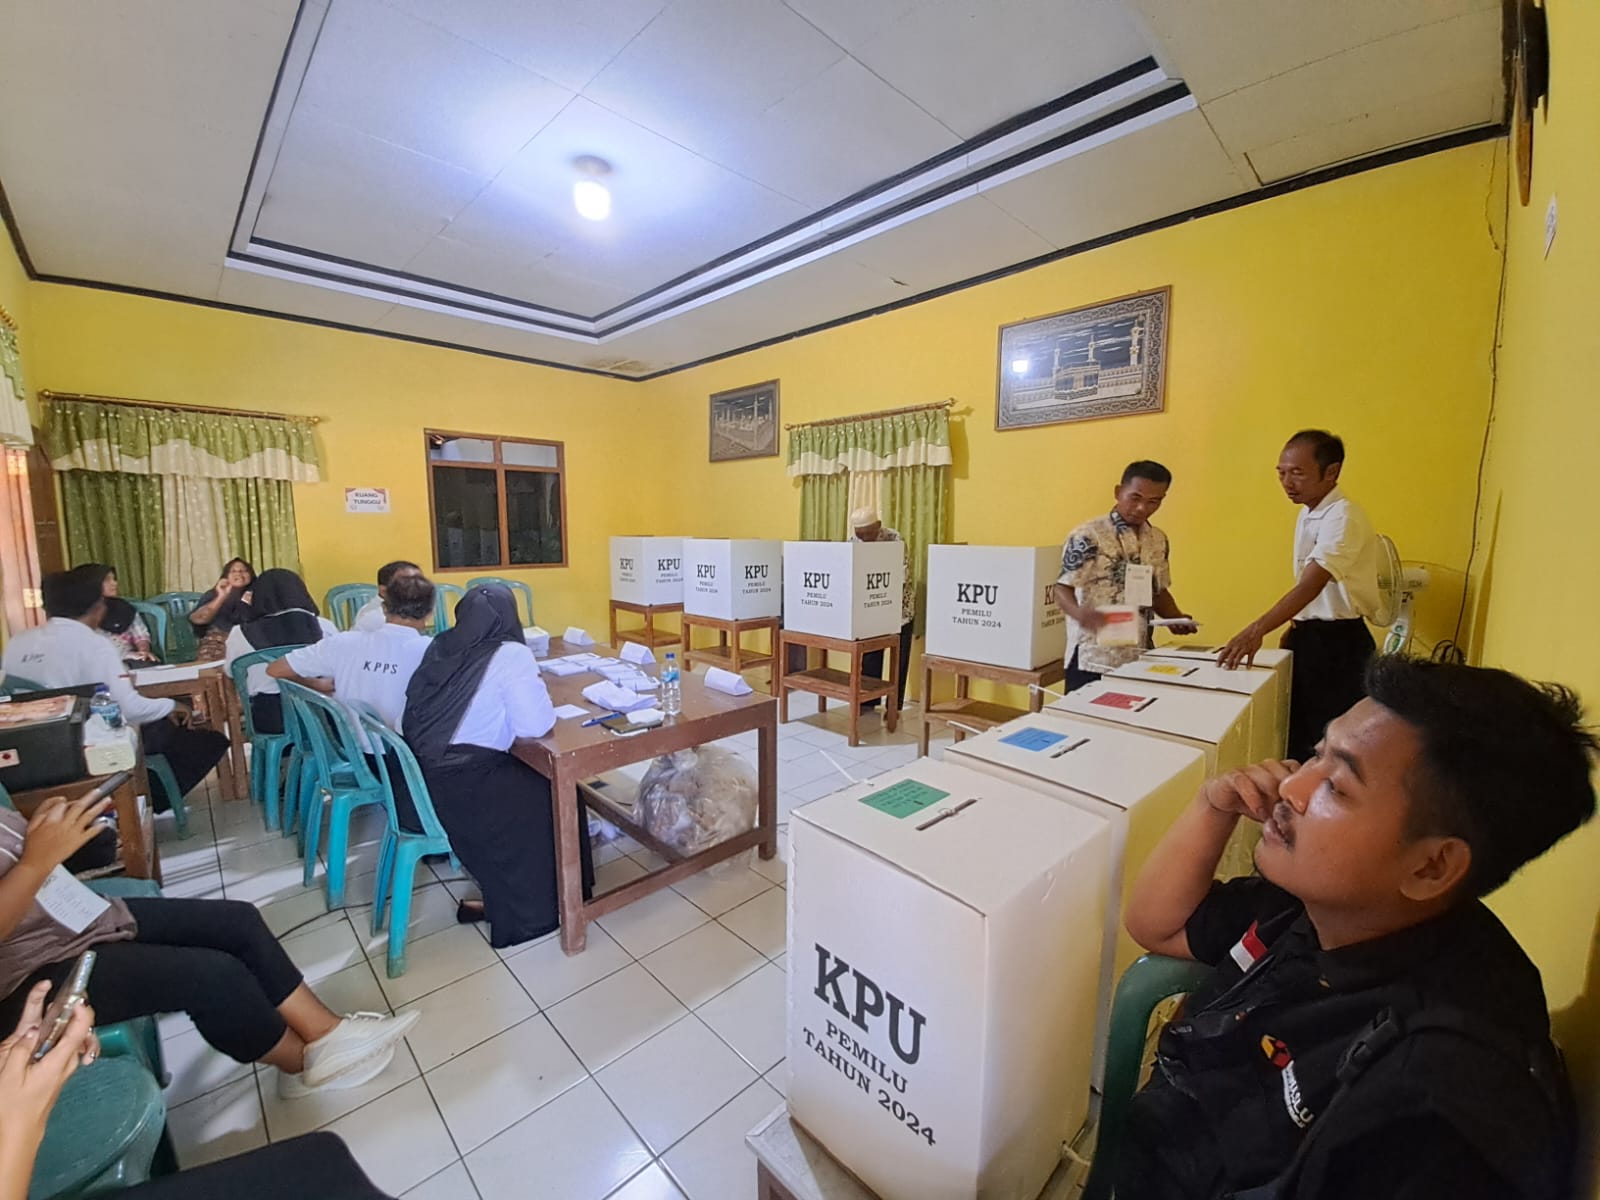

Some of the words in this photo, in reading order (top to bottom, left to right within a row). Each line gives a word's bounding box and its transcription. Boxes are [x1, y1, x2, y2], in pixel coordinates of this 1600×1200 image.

[619, 558, 634, 570] KPU
[657, 558, 681, 571] KPU
[697, 564, 716, 579] KPU
[745, 565, 769, 579] KPU
[804, 572, 830, 589] KPU
[866, 572, 890, 590] KPU
[957, 583, 999, 605] KPU
[961, 608, 992, 617] PEMILU
[952, 616, 980, 626] TAHUN
[982, 620, 1002, 628] 2024
[363, 660, 398, 674] KPPS
[814, 942, 926, 1065] KPU
[826, 1019, 908, 1094] PEMILU
[803, 1027, 871, 1094] TAHUN
[878, 1089, 936, 1146] 2024
